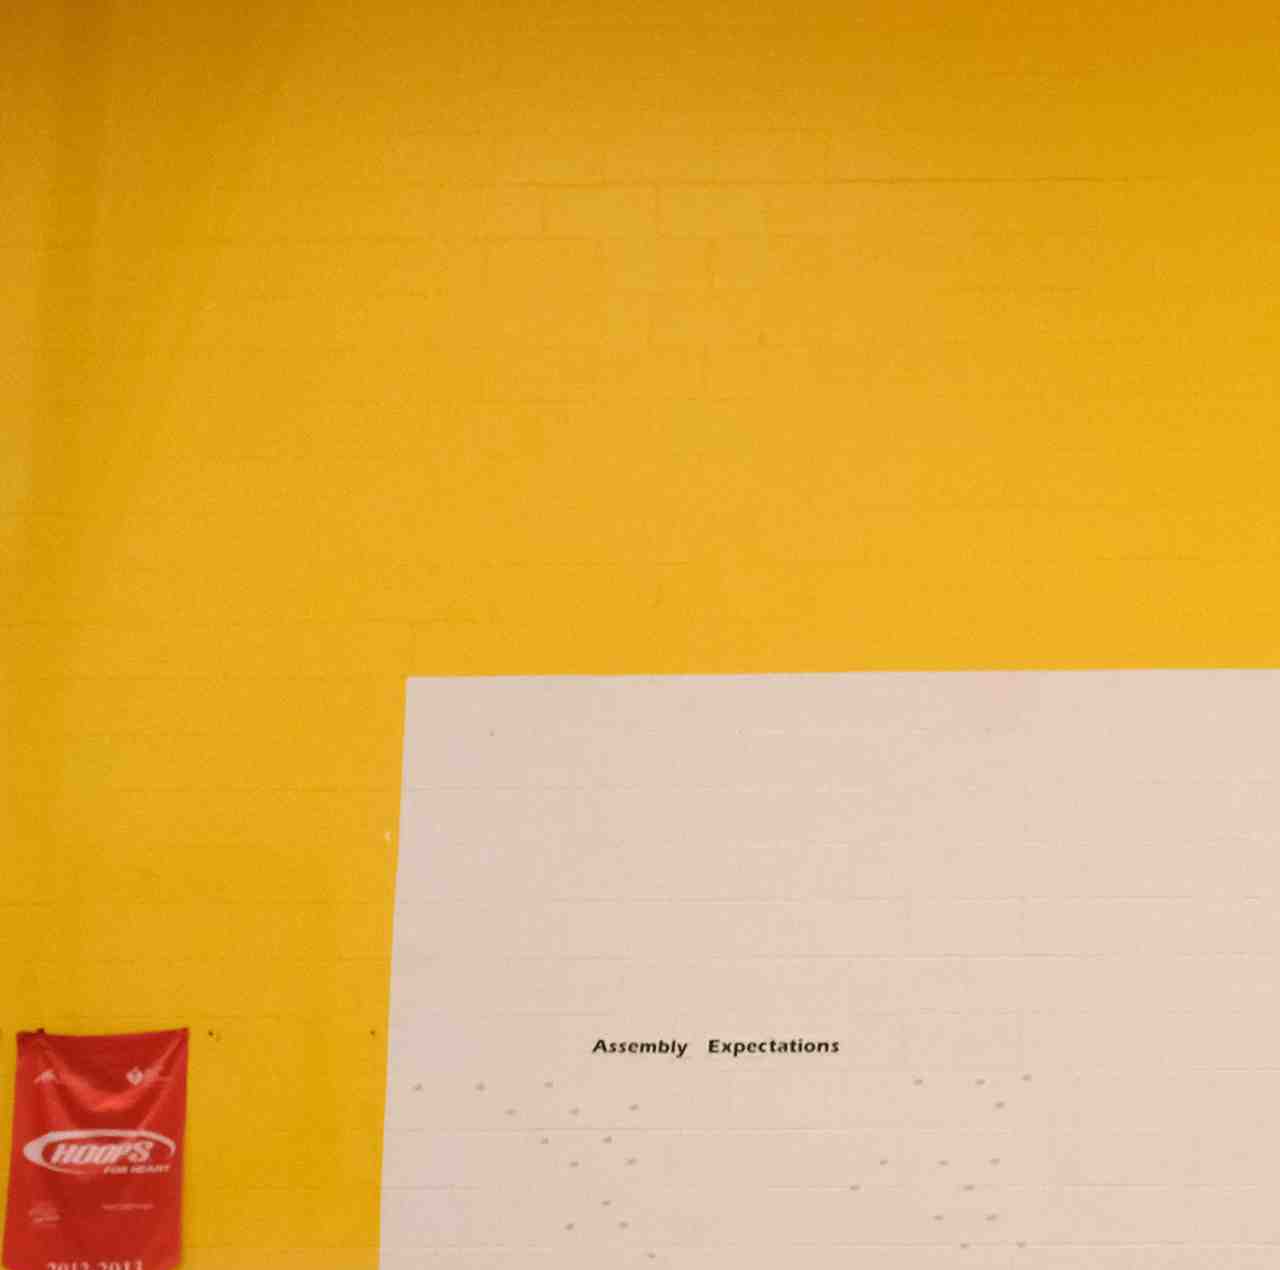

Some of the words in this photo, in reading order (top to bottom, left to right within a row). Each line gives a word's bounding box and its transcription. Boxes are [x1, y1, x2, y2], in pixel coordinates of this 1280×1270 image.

[592, 1038, 688, 1059] Assembly
[707, 1038, 840, 1057] Expectations
[50, 1141, 154, 1165] HOOPS
